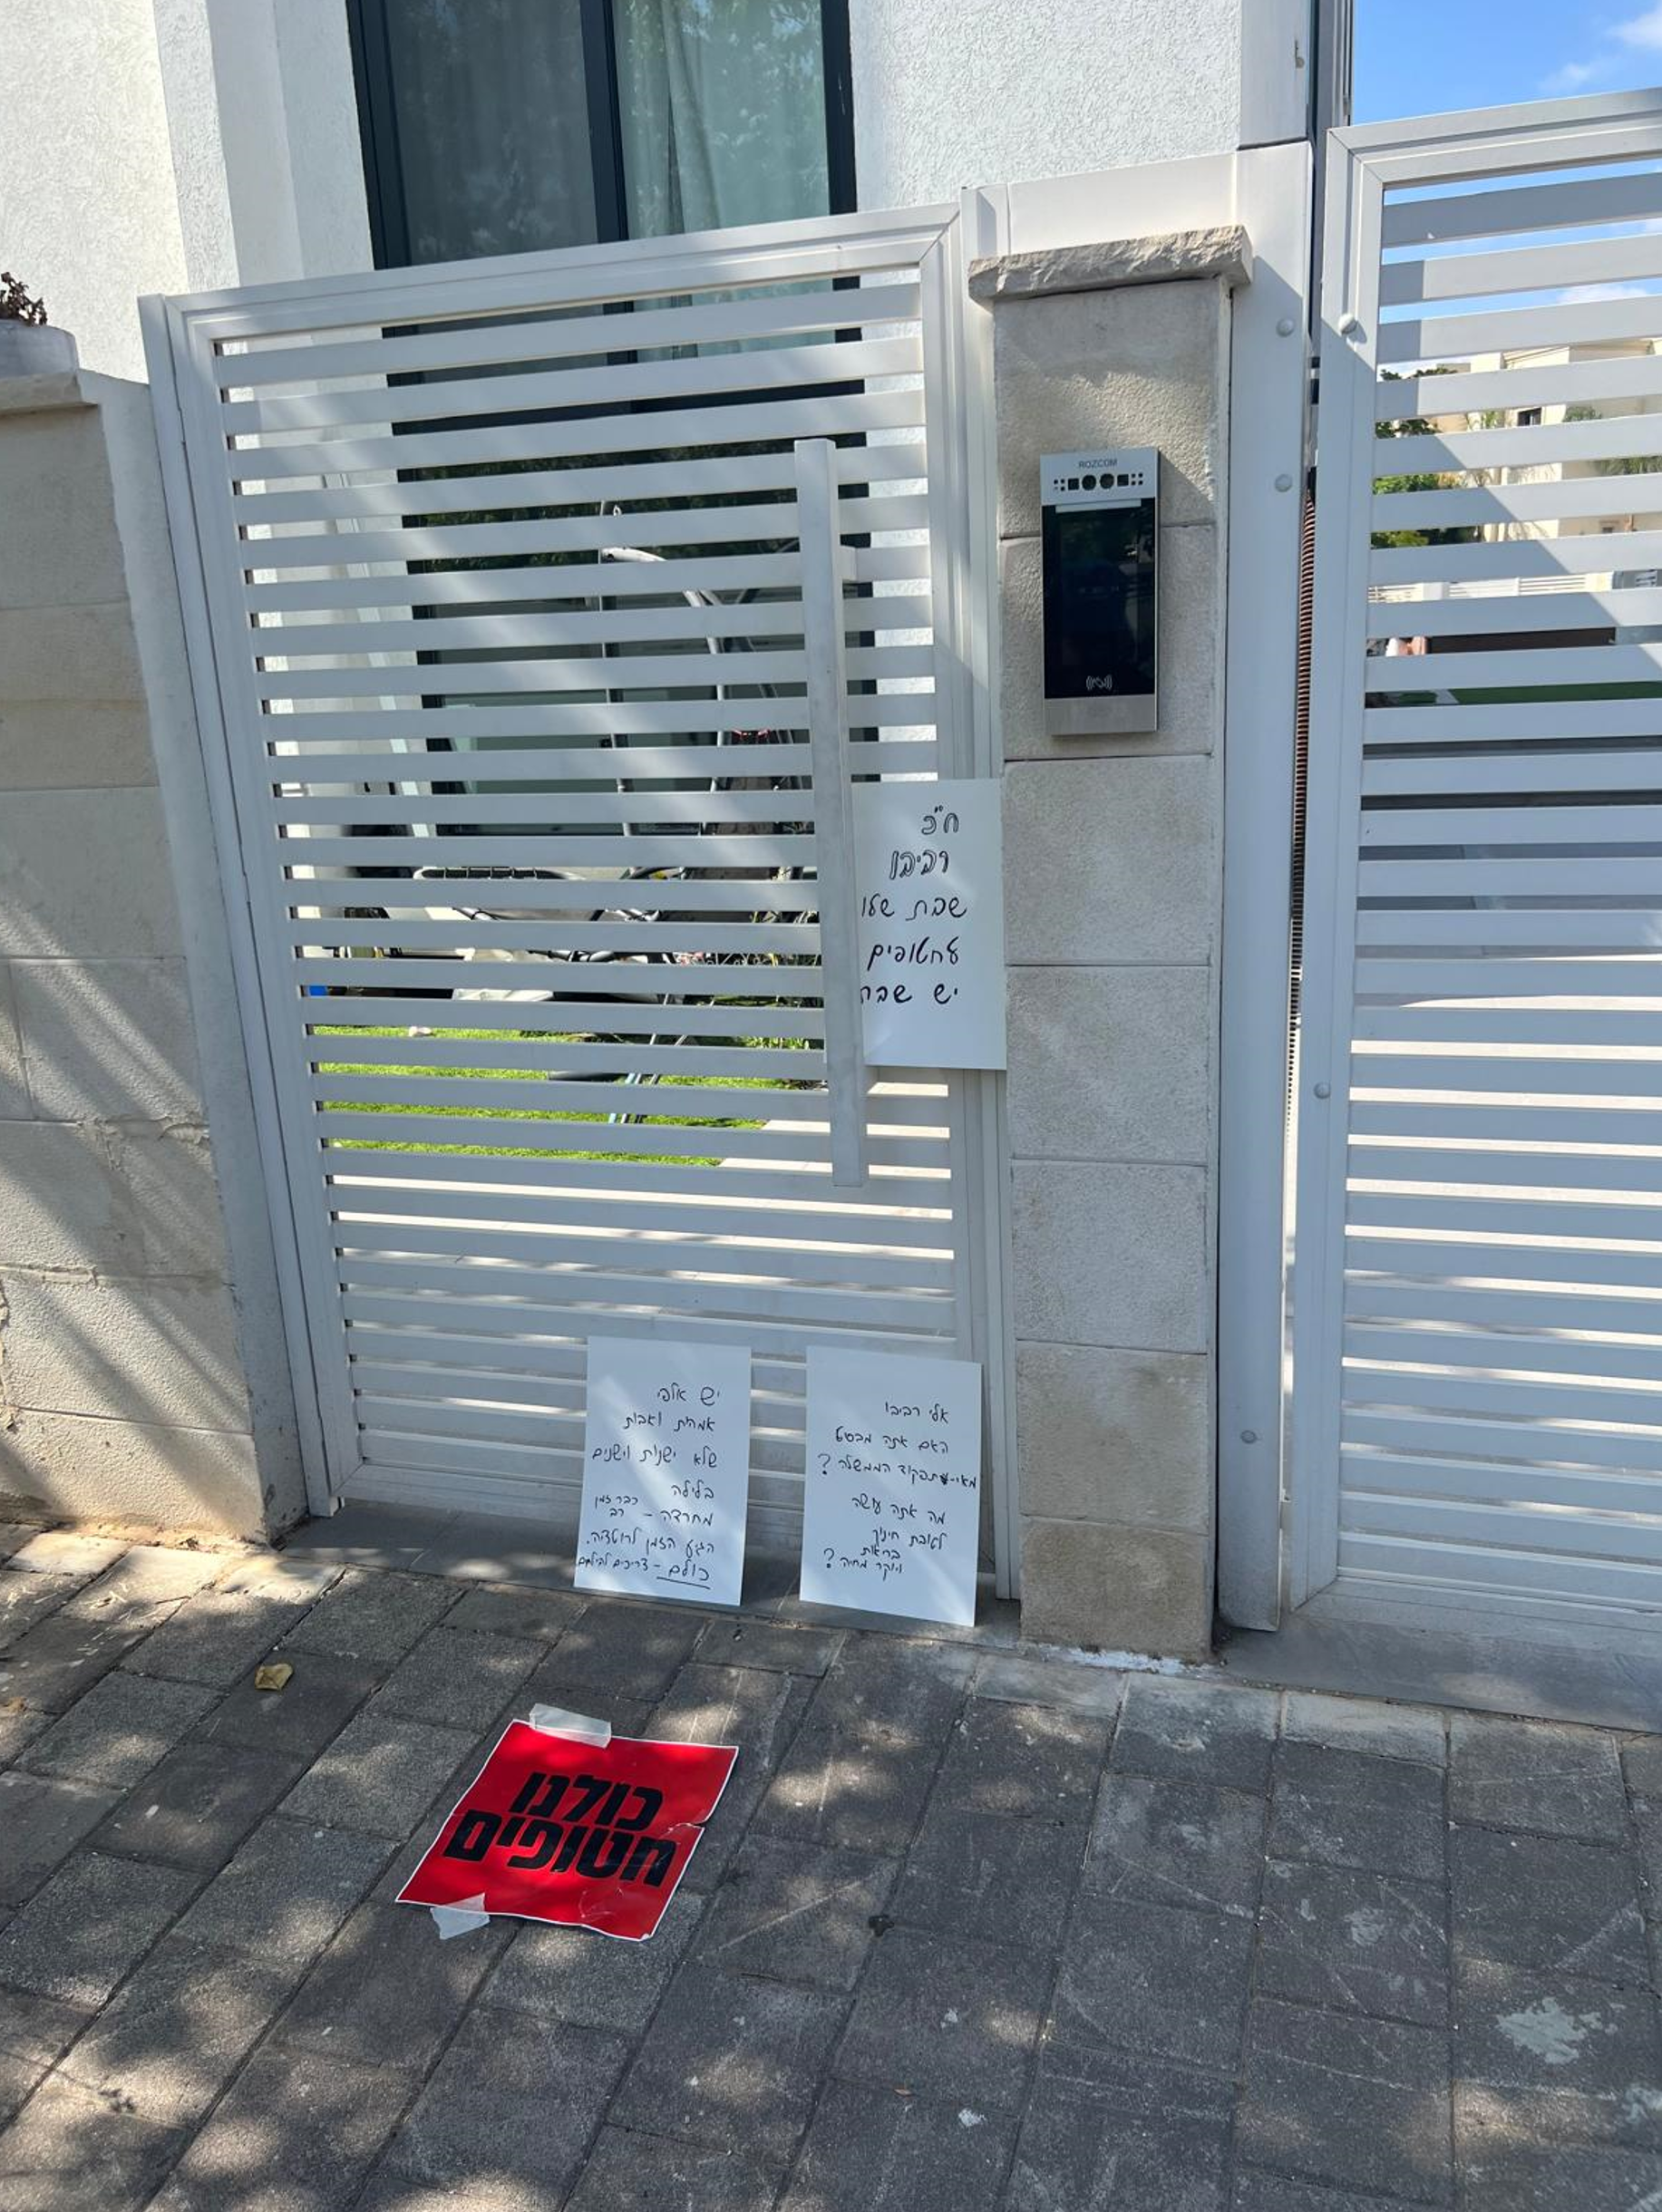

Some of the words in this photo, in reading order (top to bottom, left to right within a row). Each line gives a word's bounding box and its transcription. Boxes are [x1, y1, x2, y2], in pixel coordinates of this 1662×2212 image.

[1078, 459, 1117, 469] ROZCOM
[861, 892, 895, 917] שלו
[905, 897, 967, 921] שבת
[867, 936, 959, 972] לחטופים
[933, 983, 958, 1004] יש
[657, 1382, 687, 1402] אלפי
[700, 1386, 721, 1406] יש
[885, 1402, 920, 1417] רביבו
[929, 1403, 948, 1424] אלי
[623, 1412, 662, 1429] ואבות
[591, 1443, 630, 1461] וישנים
[882, 1435, 909, 1450] אתה
[918, 1440, 948, 1454] האם
[638, 1444, 676, 1467] ישנות
[693, 1445, 717, 1468] שלא
[671, 1480, 714, 1499] בלילה
[595, 1495, 612, 1509] זמן
[660, 1509, 714, 1527] מחרדה
[890, 1504, 918, 1520] אתה
[928, 1510, 946, 1525] מה
[872, 1526, 899, 1547] חינוך
[646, 1538, 676, 1556] הזמן
[685, 1539, 714, 1558] הגיע
[668, 1559, 710, 1581] כולם
[509, 1771, 664, 1831] כולנו
[443, 1809, 677, 1887] חטופים
